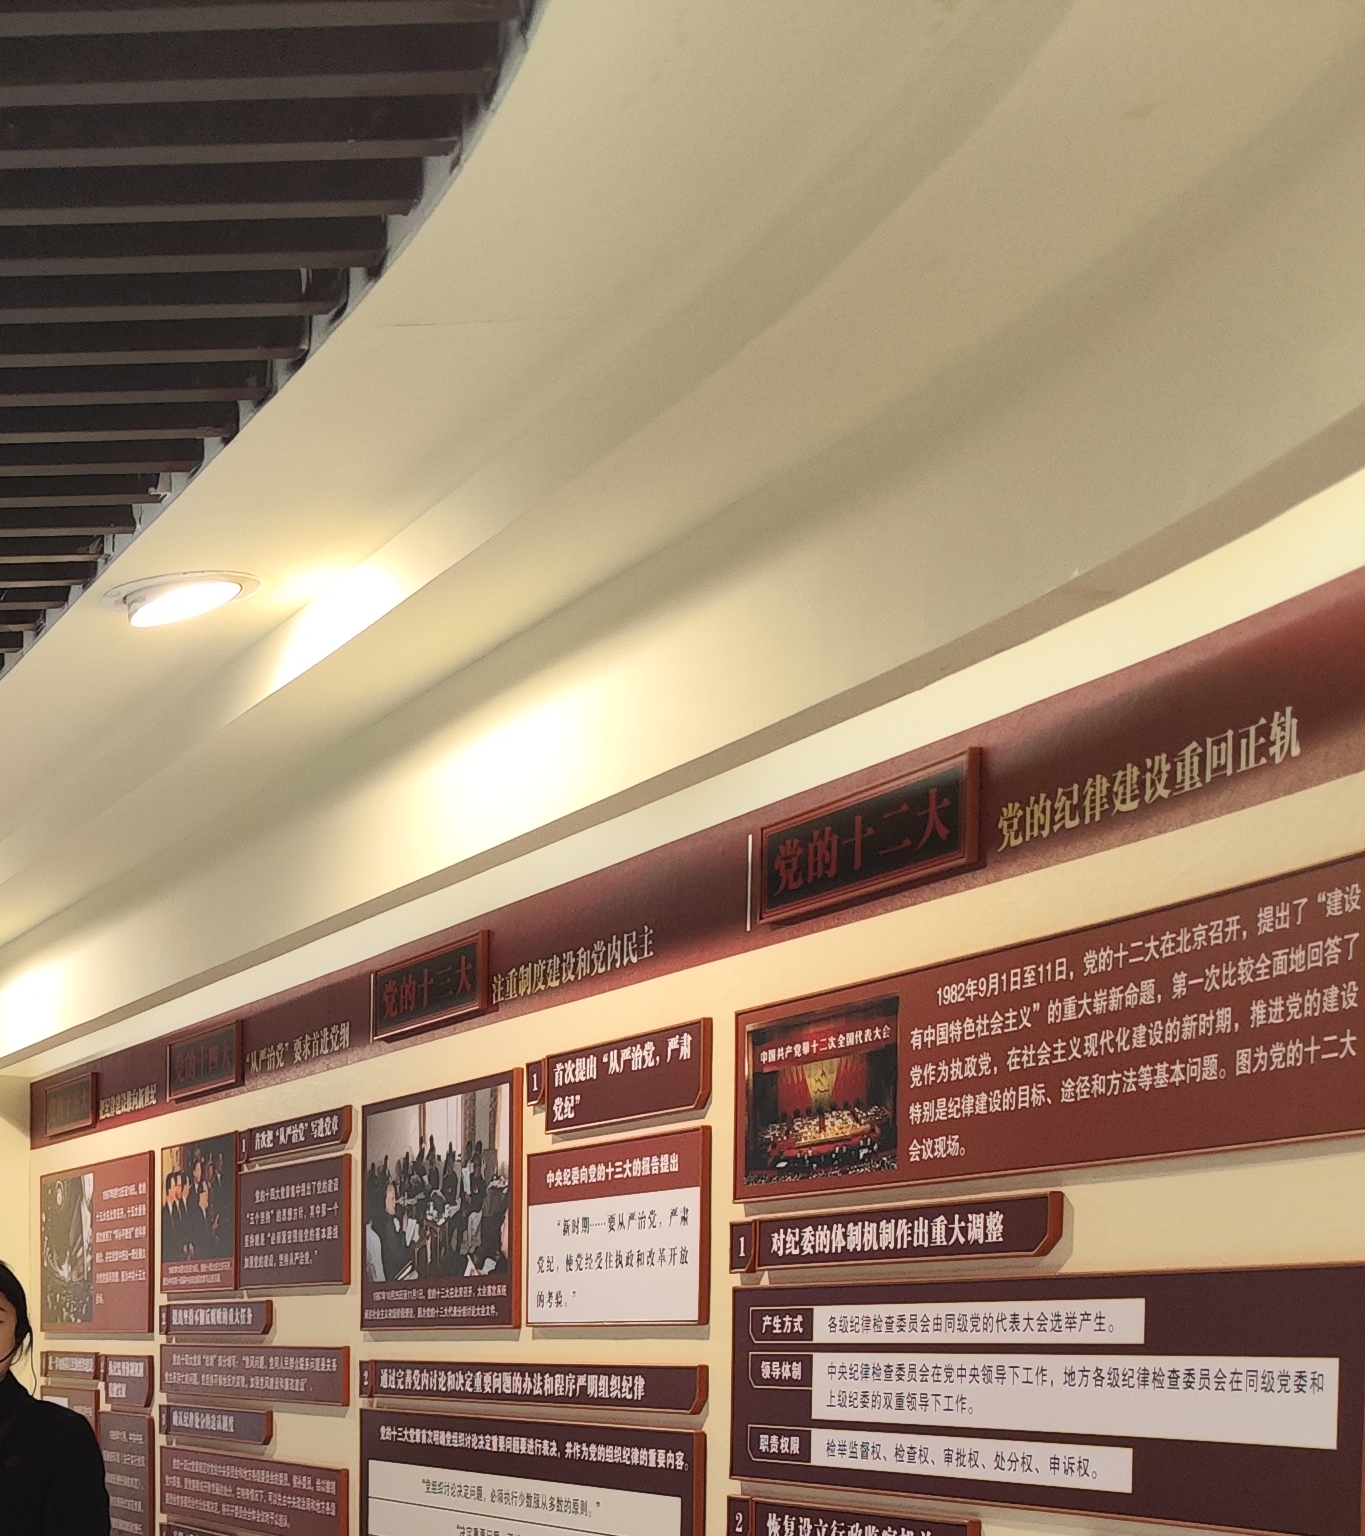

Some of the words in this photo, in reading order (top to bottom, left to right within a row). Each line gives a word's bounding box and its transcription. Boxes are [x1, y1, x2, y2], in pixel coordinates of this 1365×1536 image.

[997, 707, 1301, 853] 党的纪律建设重回正轨
[773, 787, 951, 896] 党的十二大
[491, 924, 654, 1005] 注重制度建设和党内民主
[382, 955, 472, 1020] 党的十三大
[553, 1033, 692, 1088] 首次提出“从严治党，严肃
[532, 1073, 538, 1092] 1
[553, 1095, 581, 1122] 党纪”
[909, 1135, 966, 1162] 会议现场。
[739, 1237, 745, 1257] 1
[770, 1211, 1004, 1257] 对纪委的体制机制作出重大调整
[762, 1315, 803, 1334] 产生方式
[828, 1311, 1114, 1333] 各级纪律检查委员会由同级党的代表大会选举产生。
[761, 1361, 801, 1381] 领导体制
[827, 1362, 1324, 1394] 中央纪律检查委员会在党中央领导下工作，地方各级纪律检查委员会在同级党委和
[826, 1390, 973, 1415] 上级纪委的双重领导下工作。
[760, 1434, 800, 1454] 职责权限
[826, 1439, 1097, 1479] 检举监督权、检查权、审批权、处分权、申诉权。
[735, 1512, 743, 1533] 2
